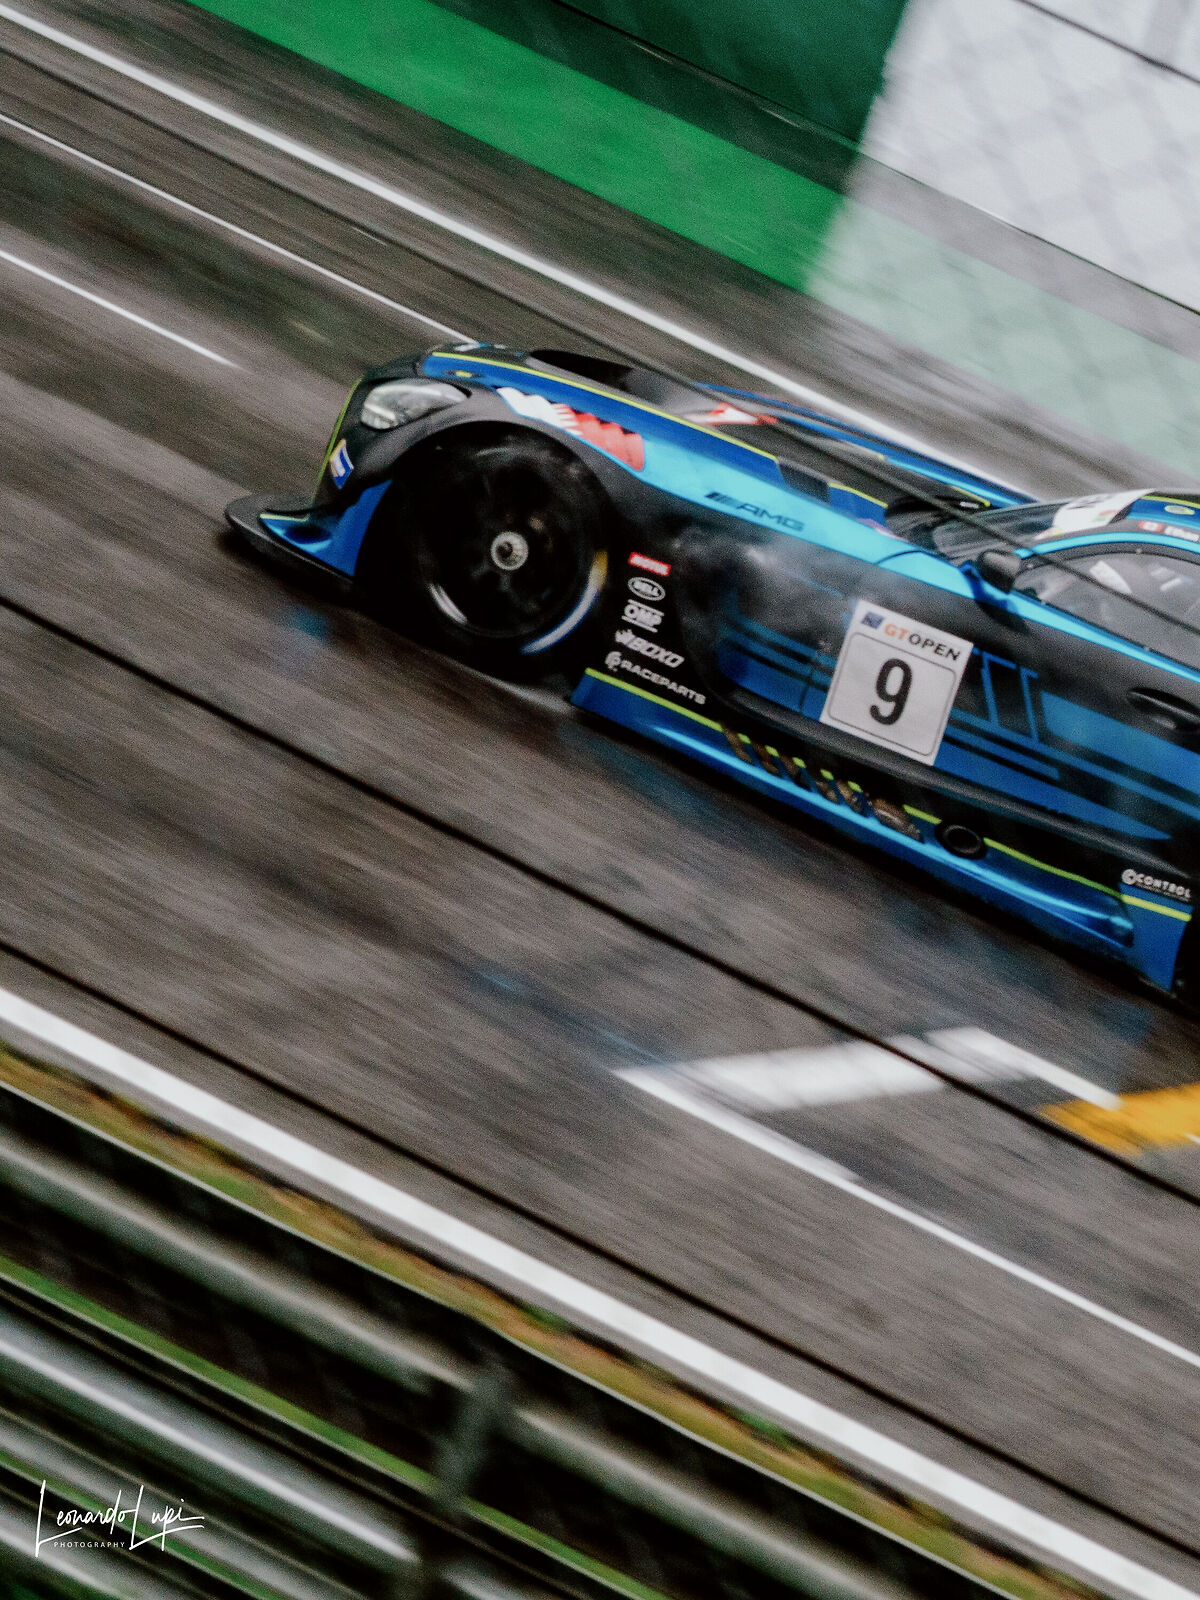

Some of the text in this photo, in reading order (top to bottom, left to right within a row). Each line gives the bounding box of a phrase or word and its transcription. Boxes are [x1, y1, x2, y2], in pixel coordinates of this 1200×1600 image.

[736, 502, 805, 532] AMG
[627, 635, 685, 668] BOXO
[620, 659, 706, 705] RACEPARTS
[869, 658, 913, 726] 9
